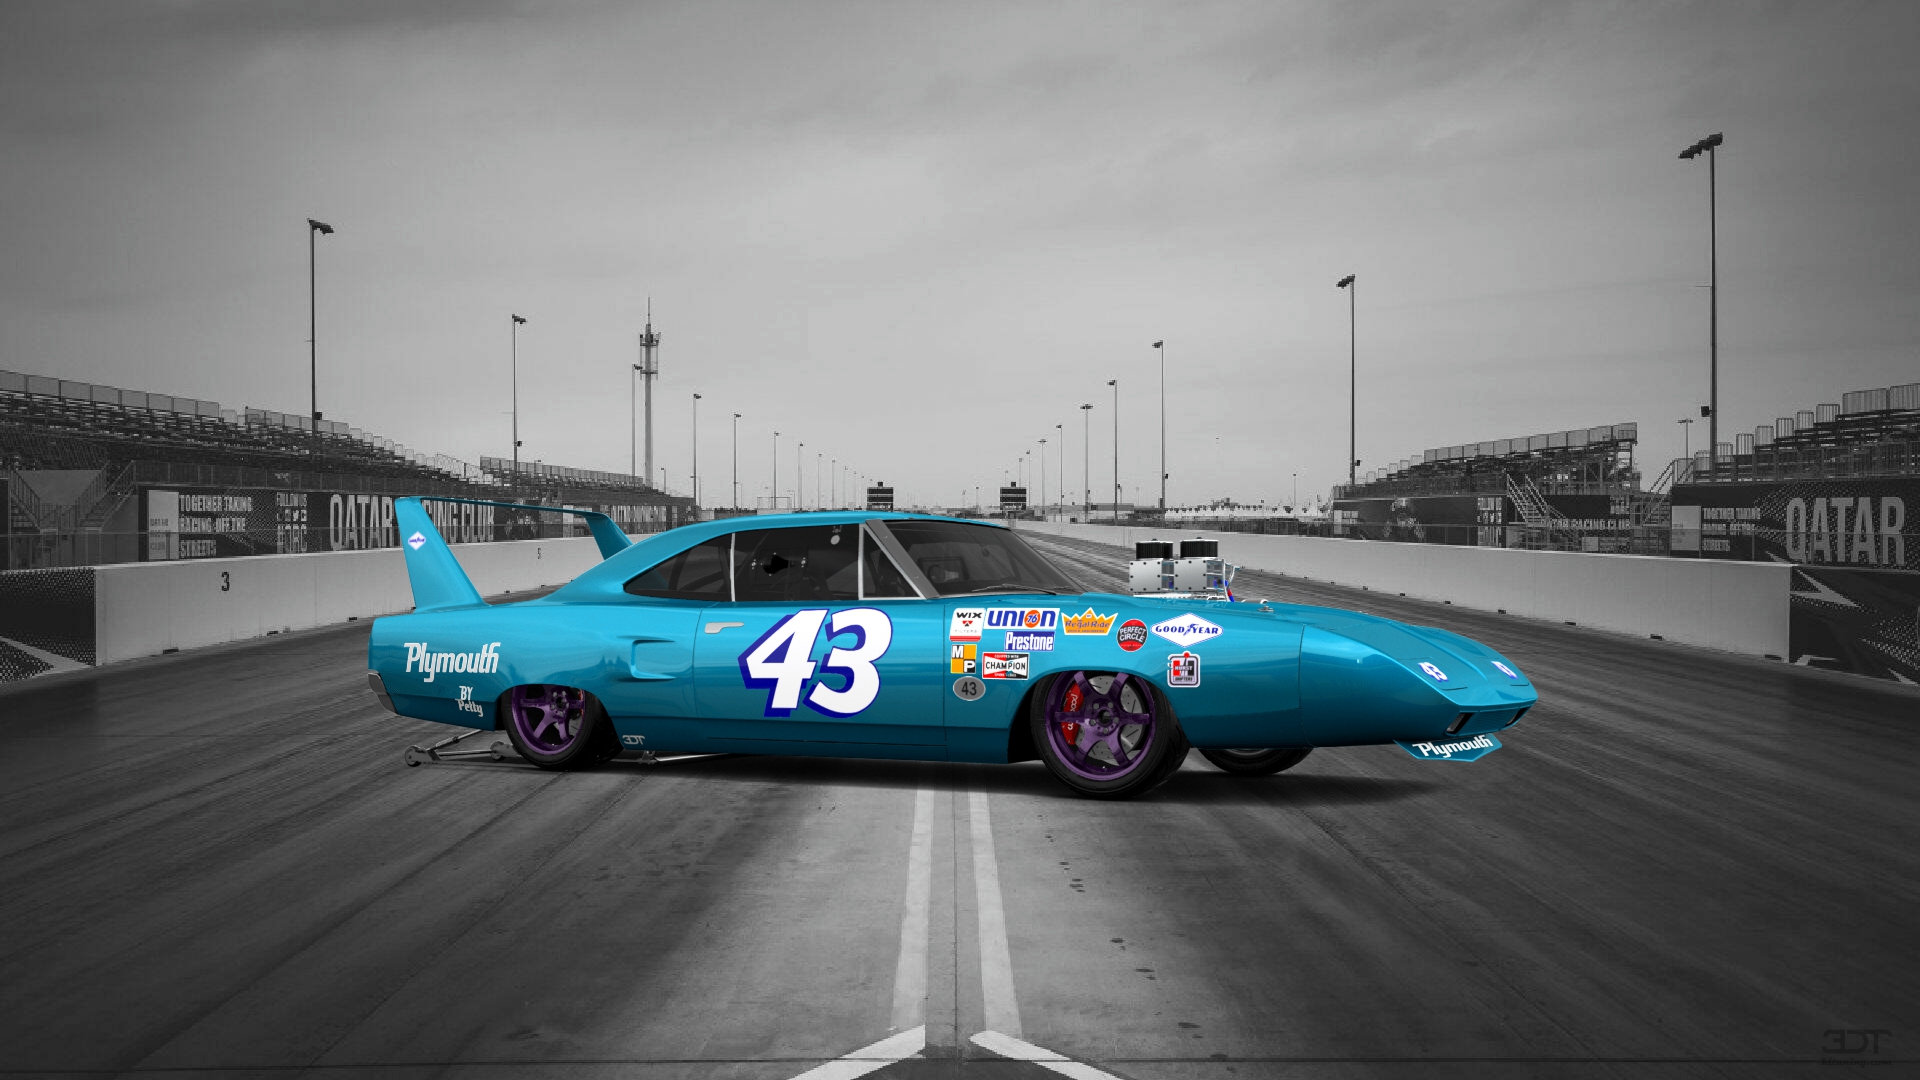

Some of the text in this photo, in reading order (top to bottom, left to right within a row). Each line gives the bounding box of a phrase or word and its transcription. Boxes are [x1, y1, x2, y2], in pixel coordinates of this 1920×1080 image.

[329, 494, 395, 551] QATAR
[1786, 496, 1905, 566] QATAR
[221, 571, 230, 592] 3
[1026, 614, 1038, 624] 76
[1065, 620, 1110, 629] Regal Ride
[1119, 626, 1147, 636] PERFECT
[1119, 633, 1145, 643] CIRCLE
[1005, 631, 1054, 651] Prestone
[952, 645, 964, 658] M
[403, 642, 502, 683] Plymouth
[737, 606, 893, 719] 43
[963, 660, 976, 673] P
[985, 661, 1026, 671] CHAMPION
[459, 685, 473, 701] BY
[961, 681, 977, 696] 43
[455, 698, 484, 718] Petty
[1412, 735, 1494, 759] Plymouth
